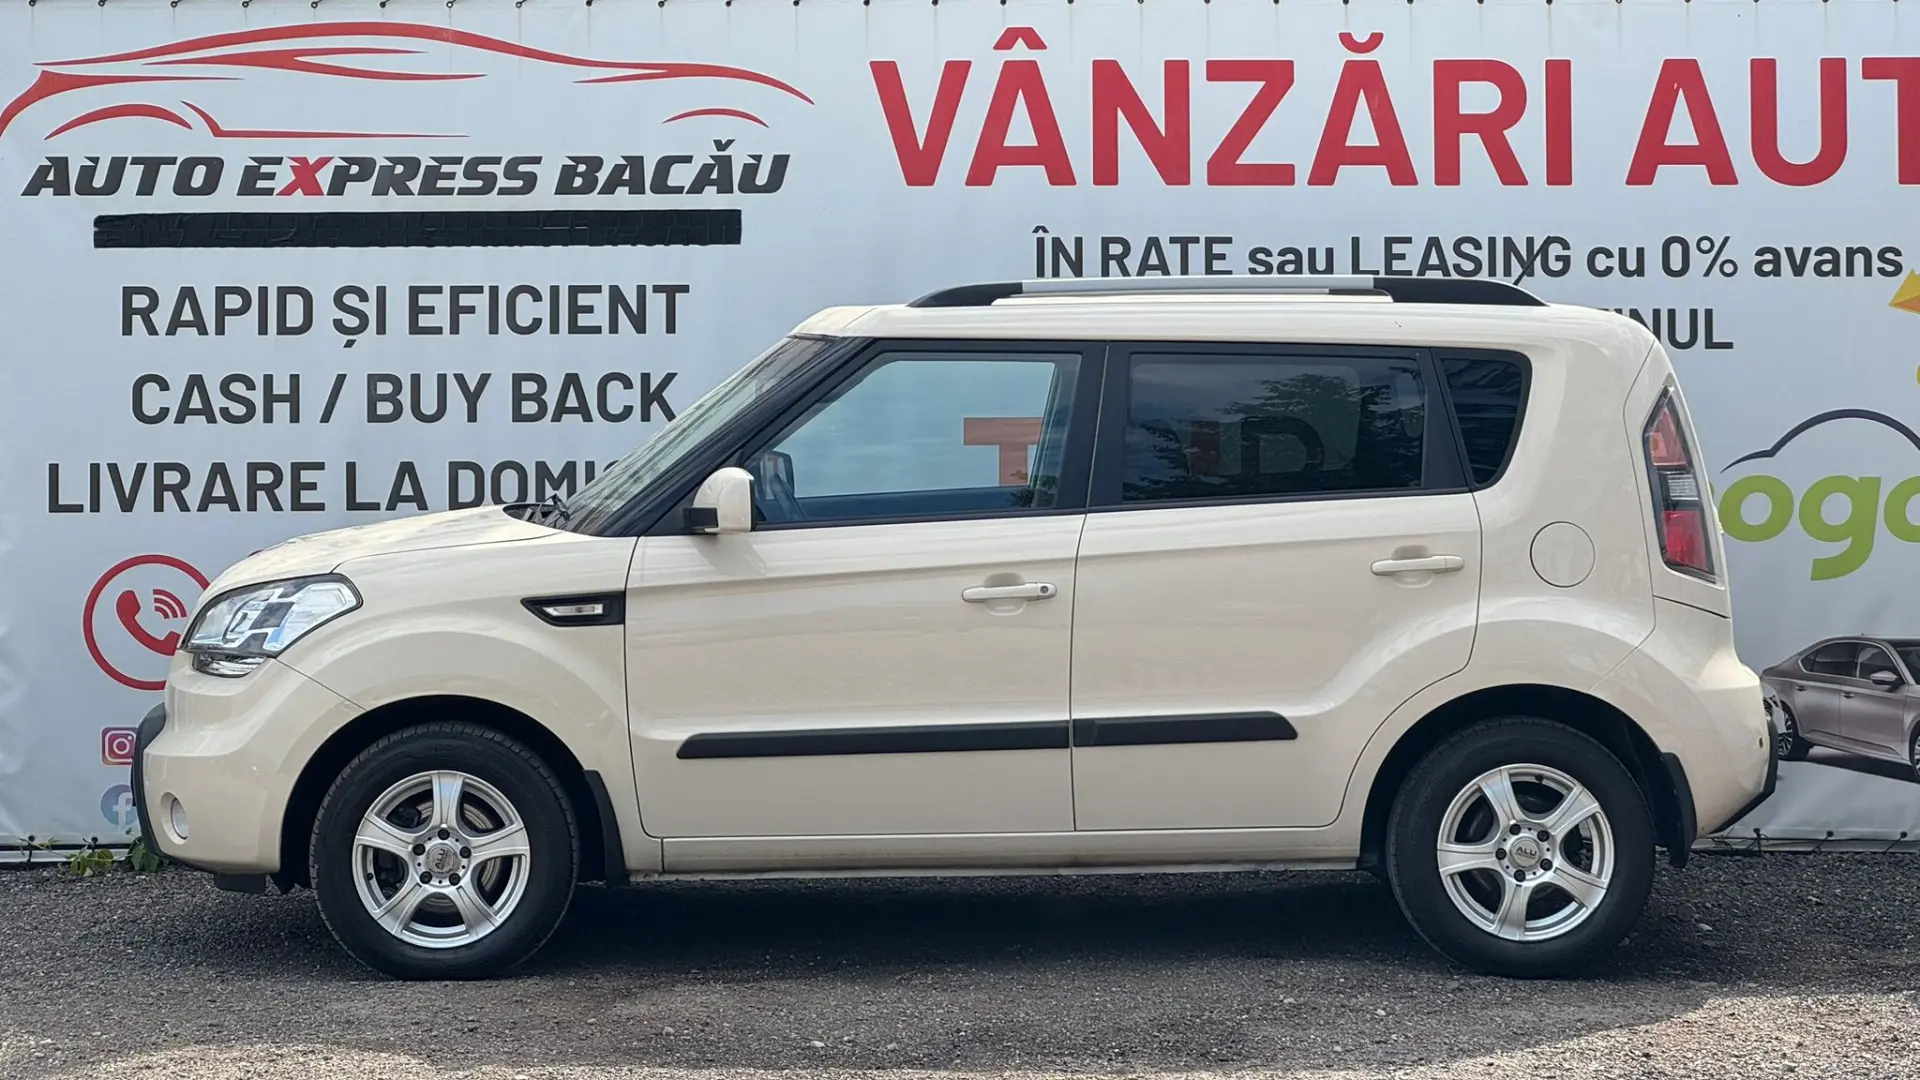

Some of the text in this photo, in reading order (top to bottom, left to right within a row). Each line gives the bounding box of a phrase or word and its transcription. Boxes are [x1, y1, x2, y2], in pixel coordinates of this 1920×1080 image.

[870, 27, 1573, 187] VÂNZĂRI
[21, 138, 791, 197] AUTO EXPRESS BACĂU
[1031, 225, 1904, 278] ÎN RATE sau LEASING cu 0% avans
[121, 284, 690, 349] RAPID ȘI EFICIENT
[131, 371, 679, 425] CASH / BUY BACK
[48, 461, 326, 514] LIVRARE
[345, 461, 429, 512] LA
